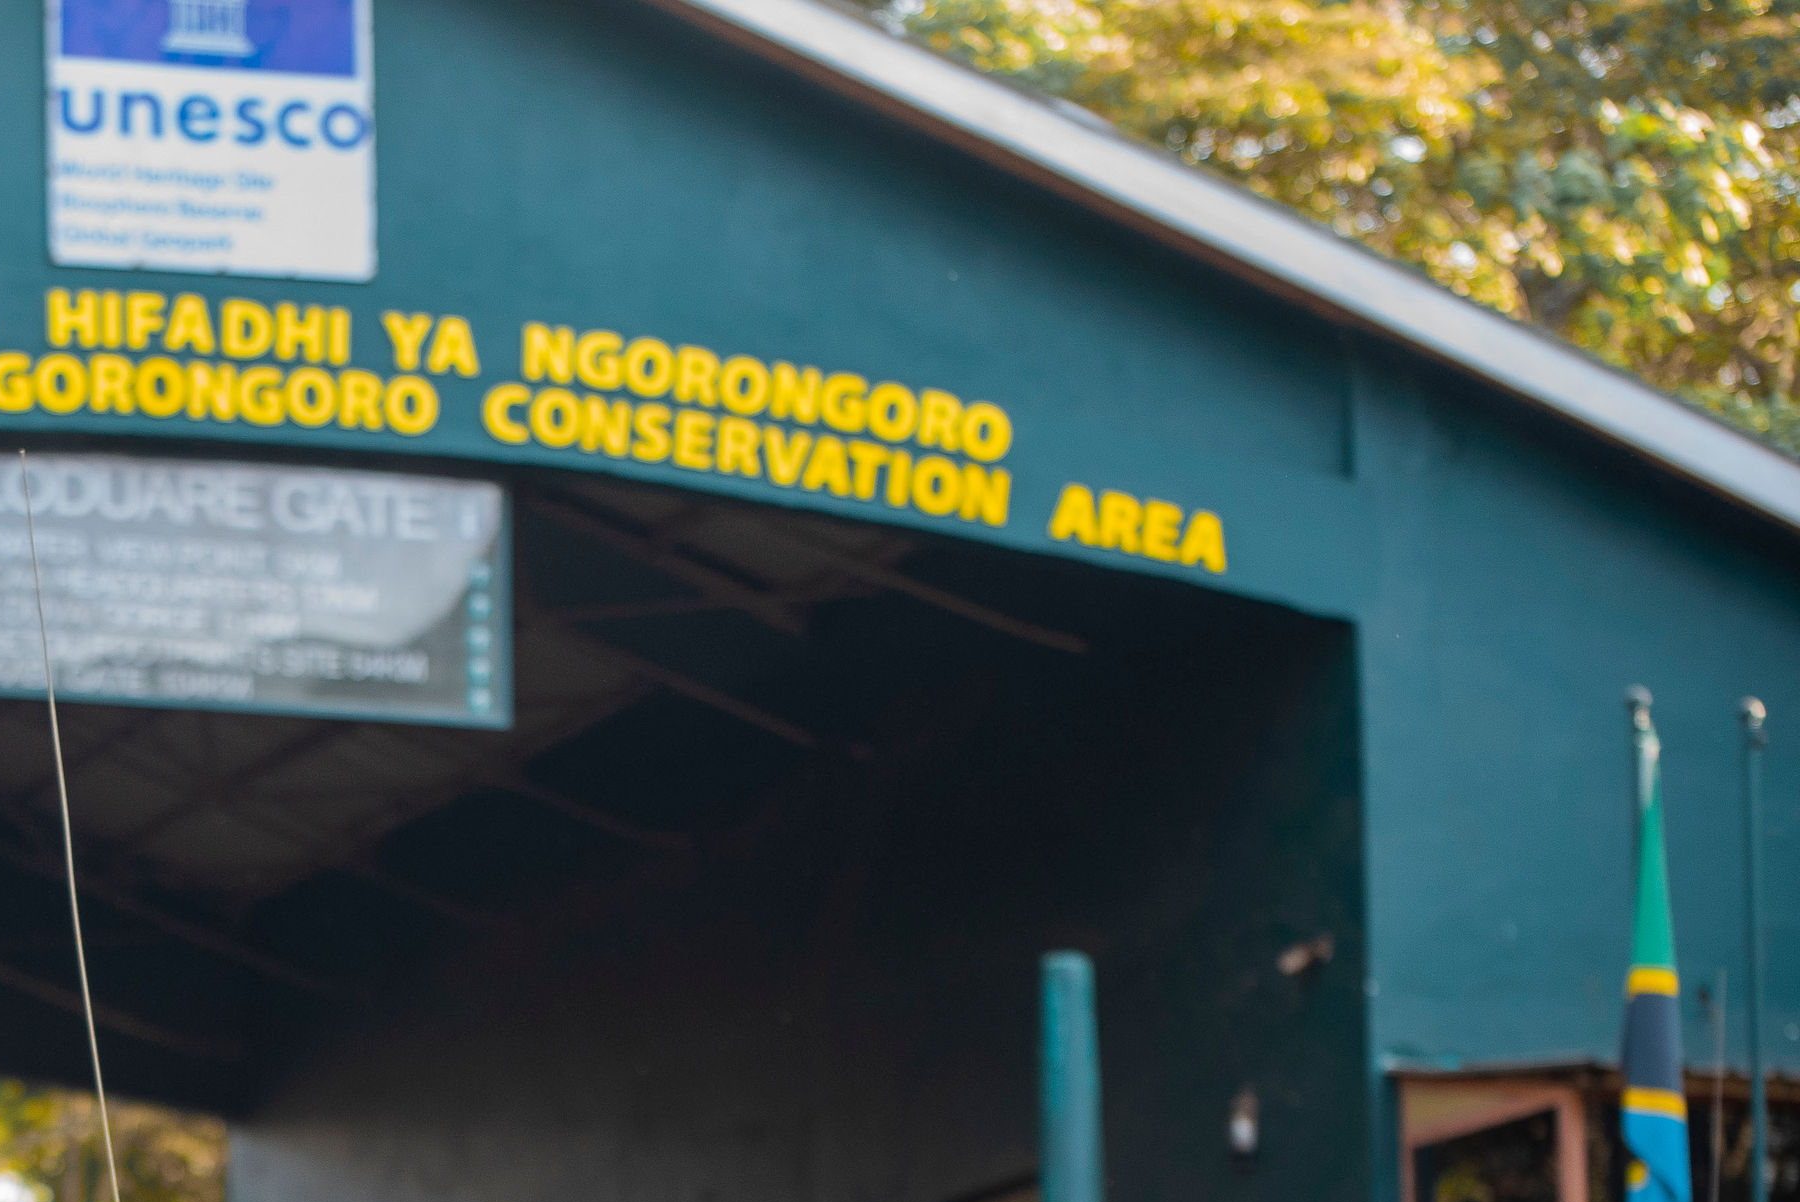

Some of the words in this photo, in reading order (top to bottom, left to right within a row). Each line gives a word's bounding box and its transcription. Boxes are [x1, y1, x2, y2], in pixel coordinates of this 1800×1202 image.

[55, 84, 371, 150] unesco
[47, 289, 350, 366] HIFADHI
[384, 313, 479, 377] YA
[523, 323, 1012, 462] NGORONGORO
[273, 475, 440, 543] GATE
[482, 384, 1011, 526] CONSERVATION
[1050, 485, 1227, 573] AREA
